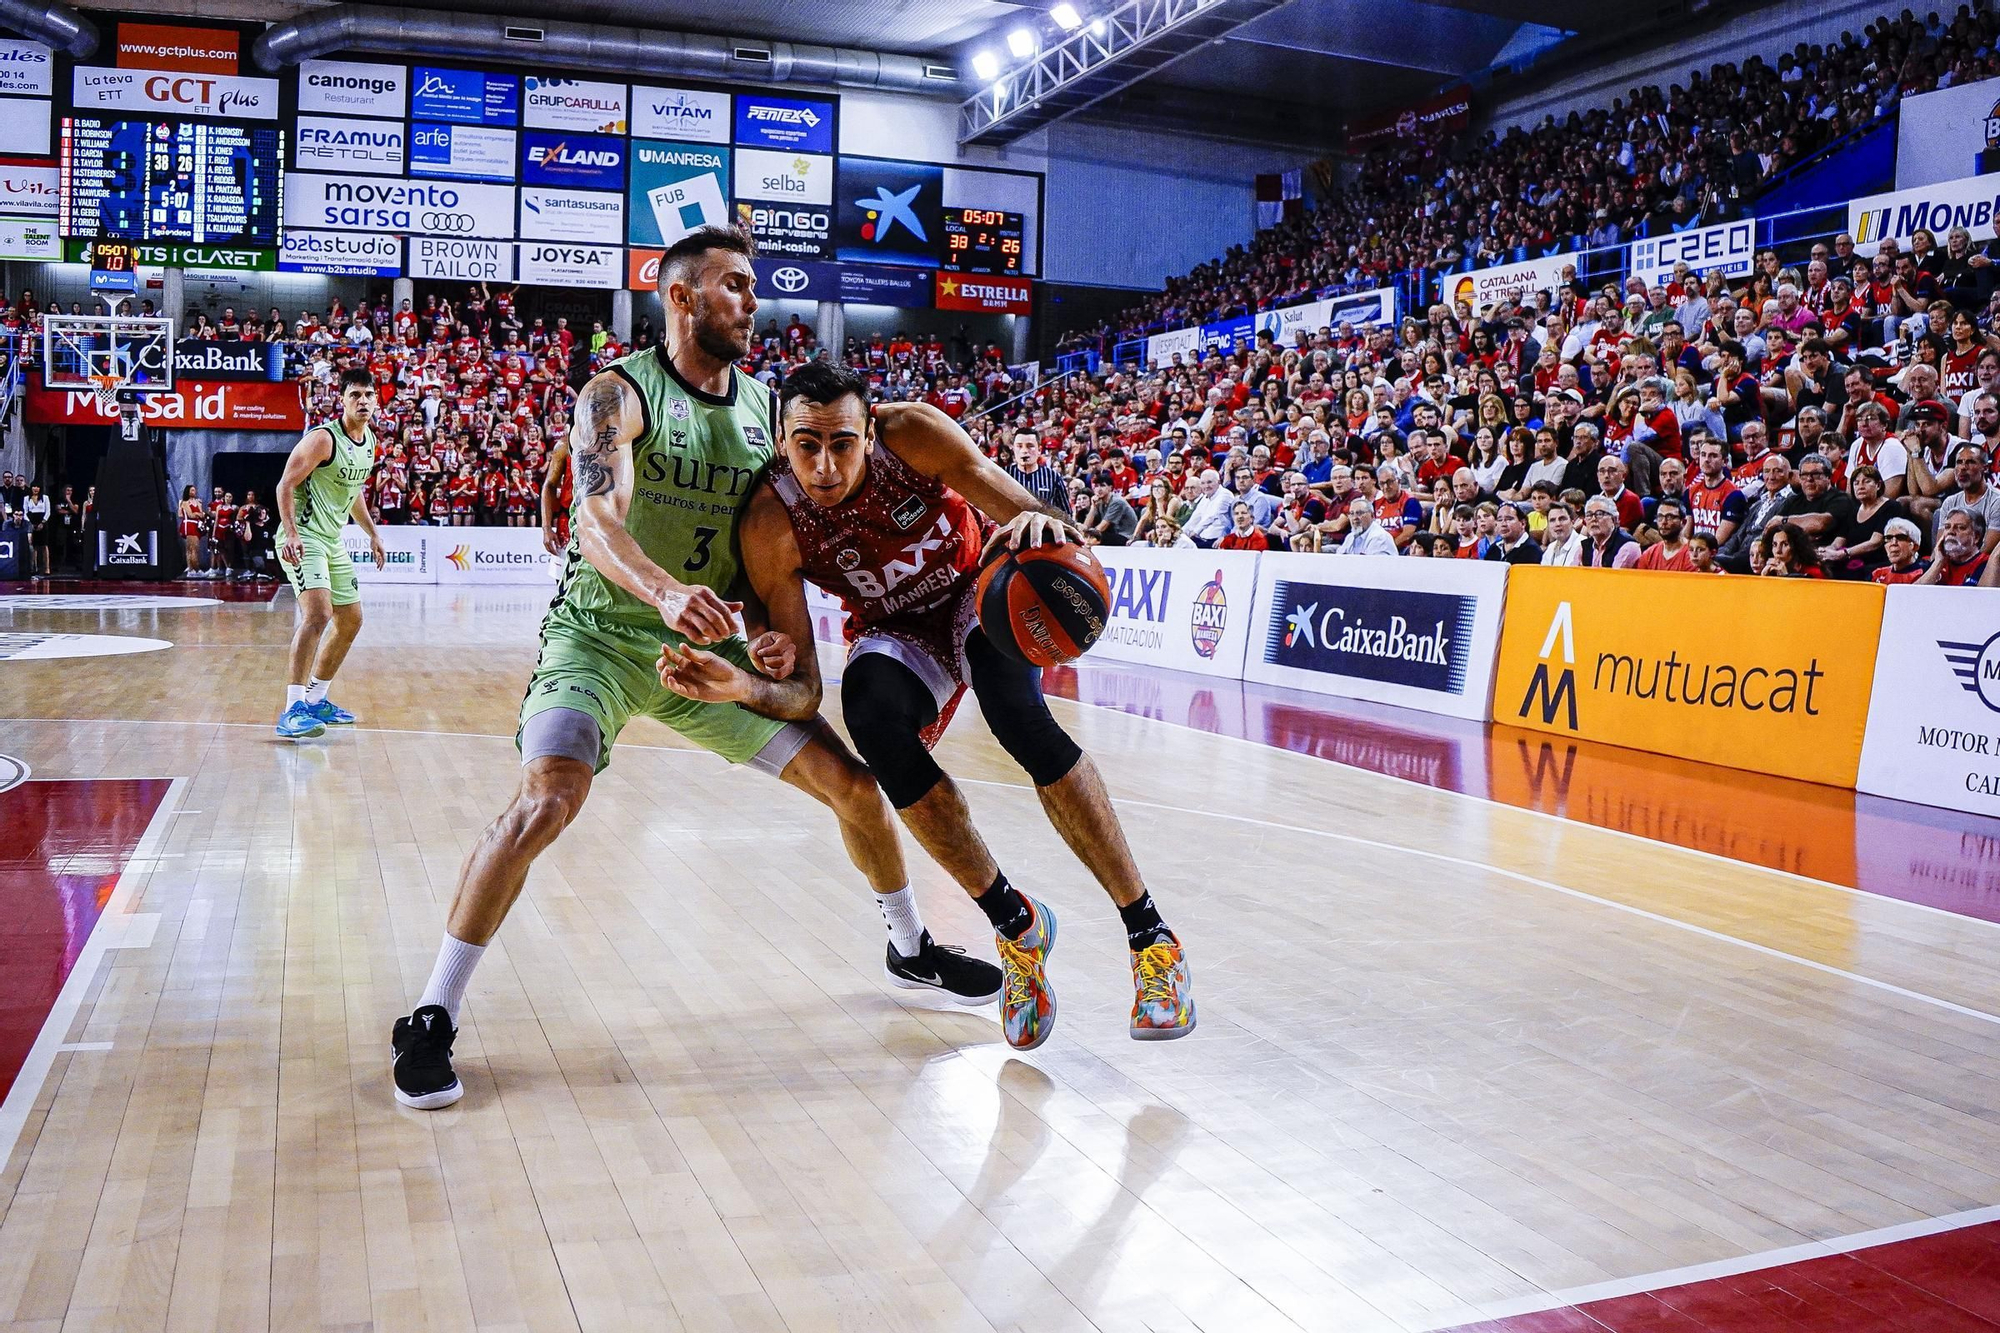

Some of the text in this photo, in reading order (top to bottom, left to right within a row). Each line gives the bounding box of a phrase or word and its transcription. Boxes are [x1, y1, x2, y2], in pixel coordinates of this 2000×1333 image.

[120, 43, 237, 60] www.gctplus.com
[14, 71, 24, 80] 14
[84, 74, 133, 86] La teva
[308, 73, 396, 94] canonge
[98, 90, 123, 101] ETT
[144, 76, 259, 114] GCT plus
[324, 92, 375, 105] Restaurant
[529, 94, 621, 111] GRUPCARULLA
[652, 104, 712, 119] VITAM
[746, 105, 803, 124] PENTEX
[81, 120, 101, 128] BADIO
[81, 130, 113, 139] ROBINSON
[299, 128, 402, 148] FRAMUN
[414, 128, 450, 147] arfe
[80, 140, 110, 149] WILLIAMS
[215, 147, 234, 156] JONES
[299, 144, 402, 162] RÈTOLS
[81, 150, 104, 158] GARCIA
[154, 154, 169, 171] 38
[214, 156, 229, 165] RIGO
[527, 142, 620, 167] EXLAND
[639, 149, 722, 168] UMANRESA
[80, 159, 103, 168] TAYLOR
[178, 155, 193, 172] 26
[169, 179, 176, 192] 2
[762, 174, 805, 192] selba
[160, 191, 189, 209] 5:07
[325, 182, 459, 208] movento
[655, 188, 686, 207] FUB
[544, 196, 620, 212] santasusana
[79, 218, 100, 227] ORIOLA
[324, 206, 411, 228] sarsa
[752, 208, 829, 231] BINGO
[963, 209, 1005, 226] 05:07
[79, 228, 98, 237] PEREZ
[945, 225, 967, 233] LOCAL
[284, 233, 397, 256] b2b.studio
[758, 240, 820, 254] mini-casino
[949, 234, 969, 249] 38
[979, 233, 987, 244] 2
[1001, 239, 1020, 254] 26
[97, 244, 128, 256] 05:07
[182, 248, 262, 267] CLARET
[285, 253, 319, 262] Marketing
[421, 240, 498, 260] BROWN
[530, 247, 613, 266] JOYSAT
[106, 256, 123, 271] 1.0
[302, 264, 378, 276] www.b2b.studio
[421, 259, 497, 279] TAILOR
[1007, 257, 1016, 268] 2
[1480, 270, 1537, 288] CATALANA
[961, 283, 1029, 302] ESTRELLA
[1480, 283, 1538, 302] DE TREALL
[1284, 310, 1303, 324] Salut
[194, 384, 226, 420] id
[597, 424, 618, 453] 虎
[637, 485, 708, 513] seguros &
[897, 510, 910, 523] liga
[902, 505, 925, 527] endesa
[1692, 508, 1721, 526] BAXI
[343, 538, 361, 549] YOU
[684, 526, 720, 572] 3
[108, 555, 148, 565] CaixaBank
[843, 512, 952, 598] BAXI
[880, 563, 961, 615] MANRESA
[1193, 603, 1228, 628] BAXI
[1319, 606, 1450, 667] CaixaBank
[1593, 650, 1825, 717] mutuacat
[1917, 725, 1990, 756] MOTOR
